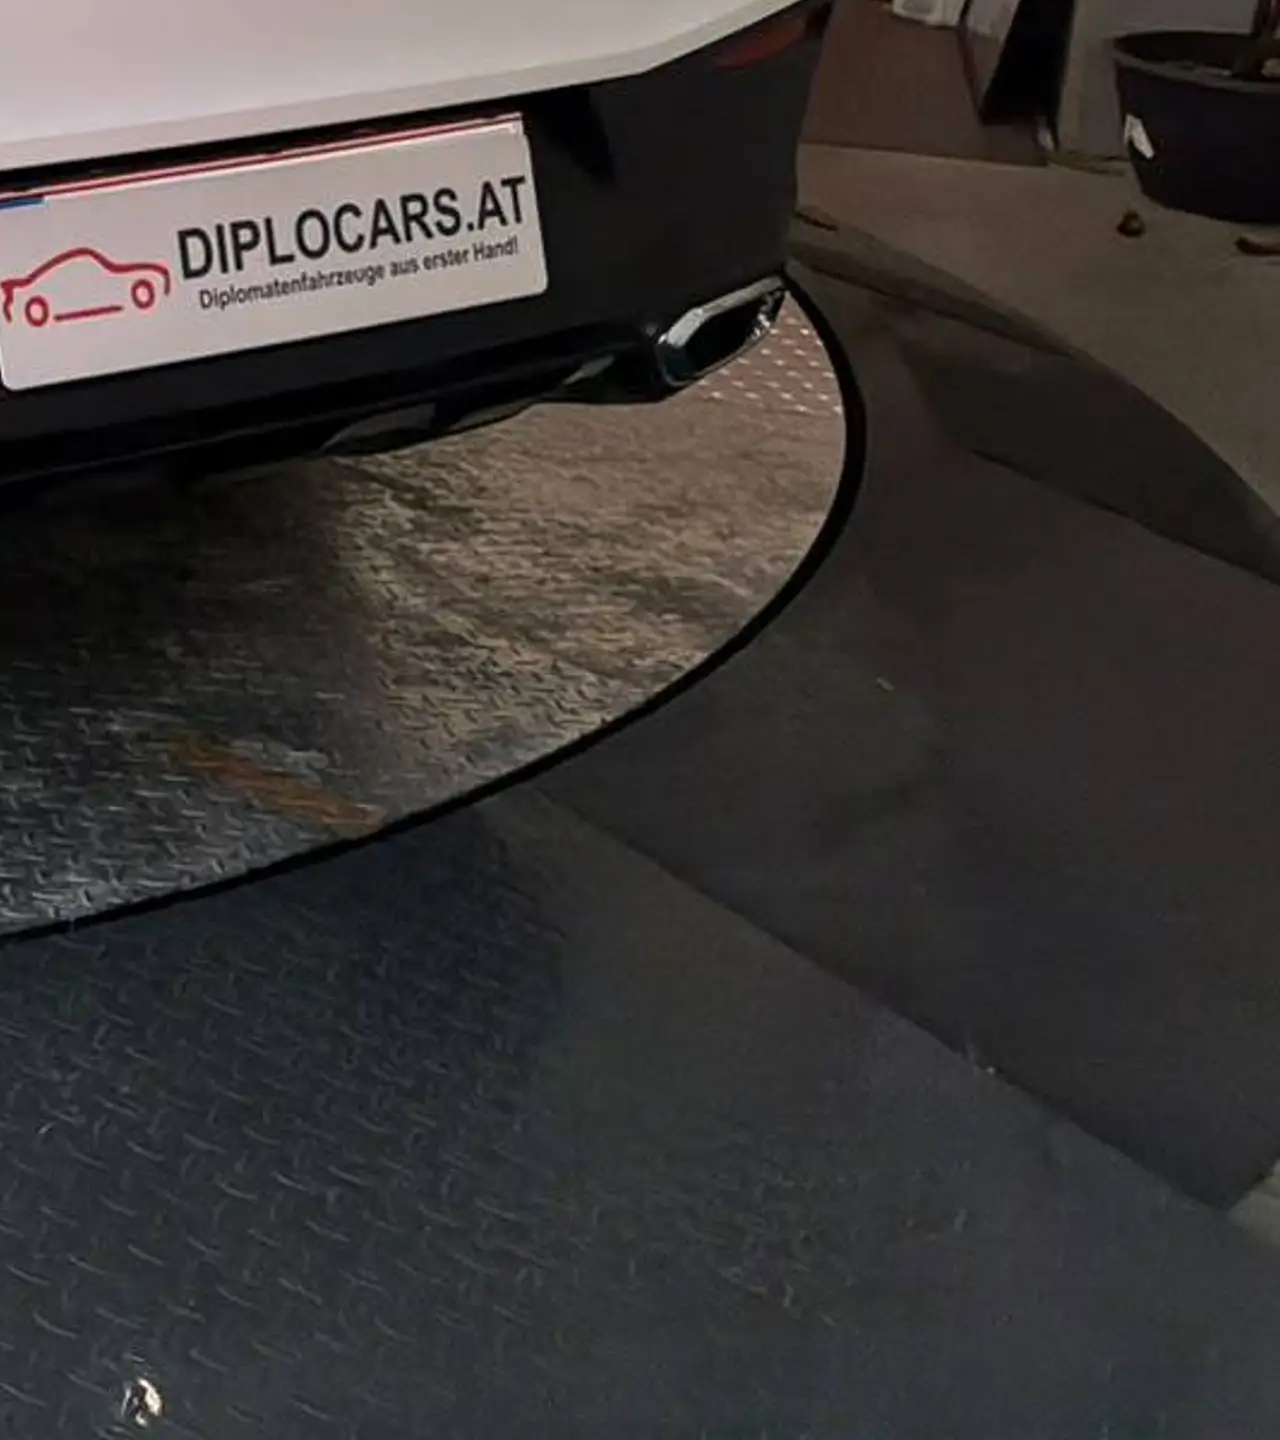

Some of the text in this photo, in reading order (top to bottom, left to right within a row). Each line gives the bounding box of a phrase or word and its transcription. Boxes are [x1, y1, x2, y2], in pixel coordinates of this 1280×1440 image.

[177, 176, 526, 280] DIPLOCARS.AT
[200, 236, 519, 311] Diplomatenfahrzeuge aus erster Hand!
